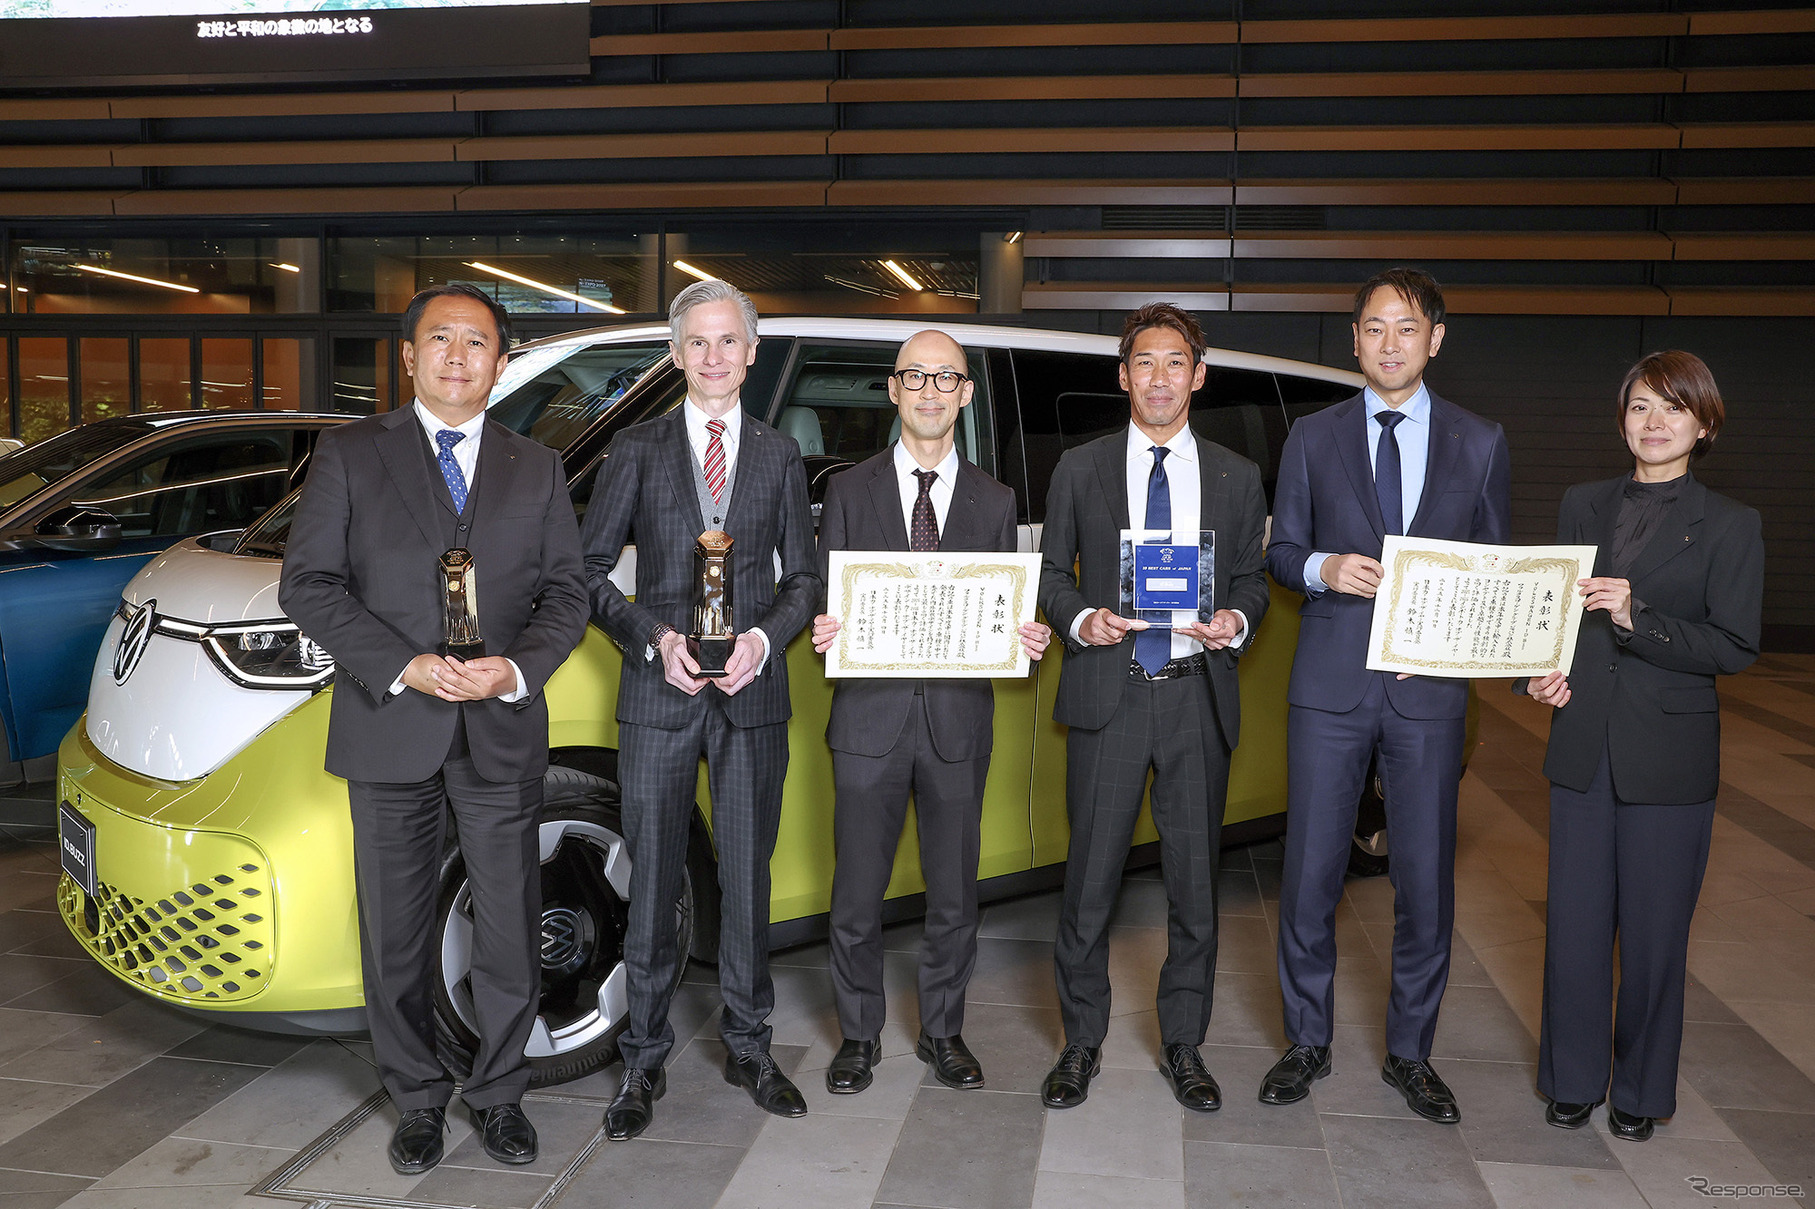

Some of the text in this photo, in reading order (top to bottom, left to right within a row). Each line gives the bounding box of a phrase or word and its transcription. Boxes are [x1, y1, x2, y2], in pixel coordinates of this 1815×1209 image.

[197, 17, 373, 38] 友好と平和の象徴の地となる
[991, 594, 1005, 634] 表彰状
[1536, 590, 1553, 631] 表彰状
[530, 1045, 614, 1082] Continenta
